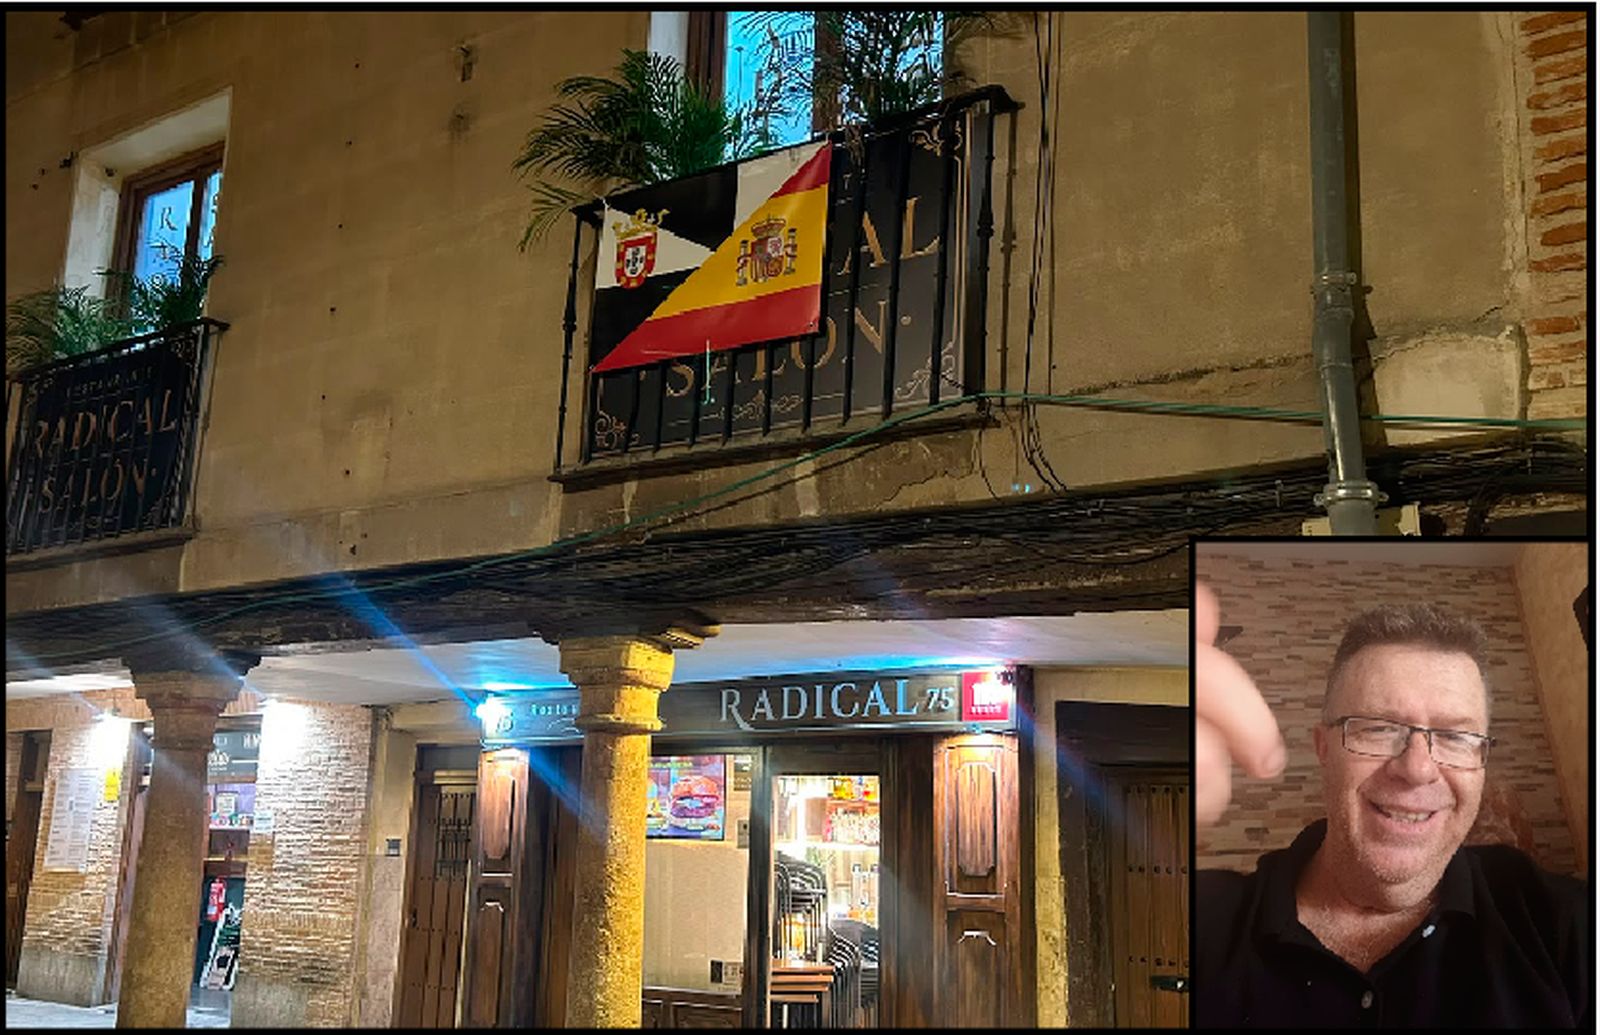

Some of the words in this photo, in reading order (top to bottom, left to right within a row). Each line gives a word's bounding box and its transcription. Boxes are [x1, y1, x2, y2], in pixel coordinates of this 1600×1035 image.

[34, 388, 178, 459] RADICAL
[720, 679, 919, 731] RADICAL
[926, 686, 955, 711] 75
